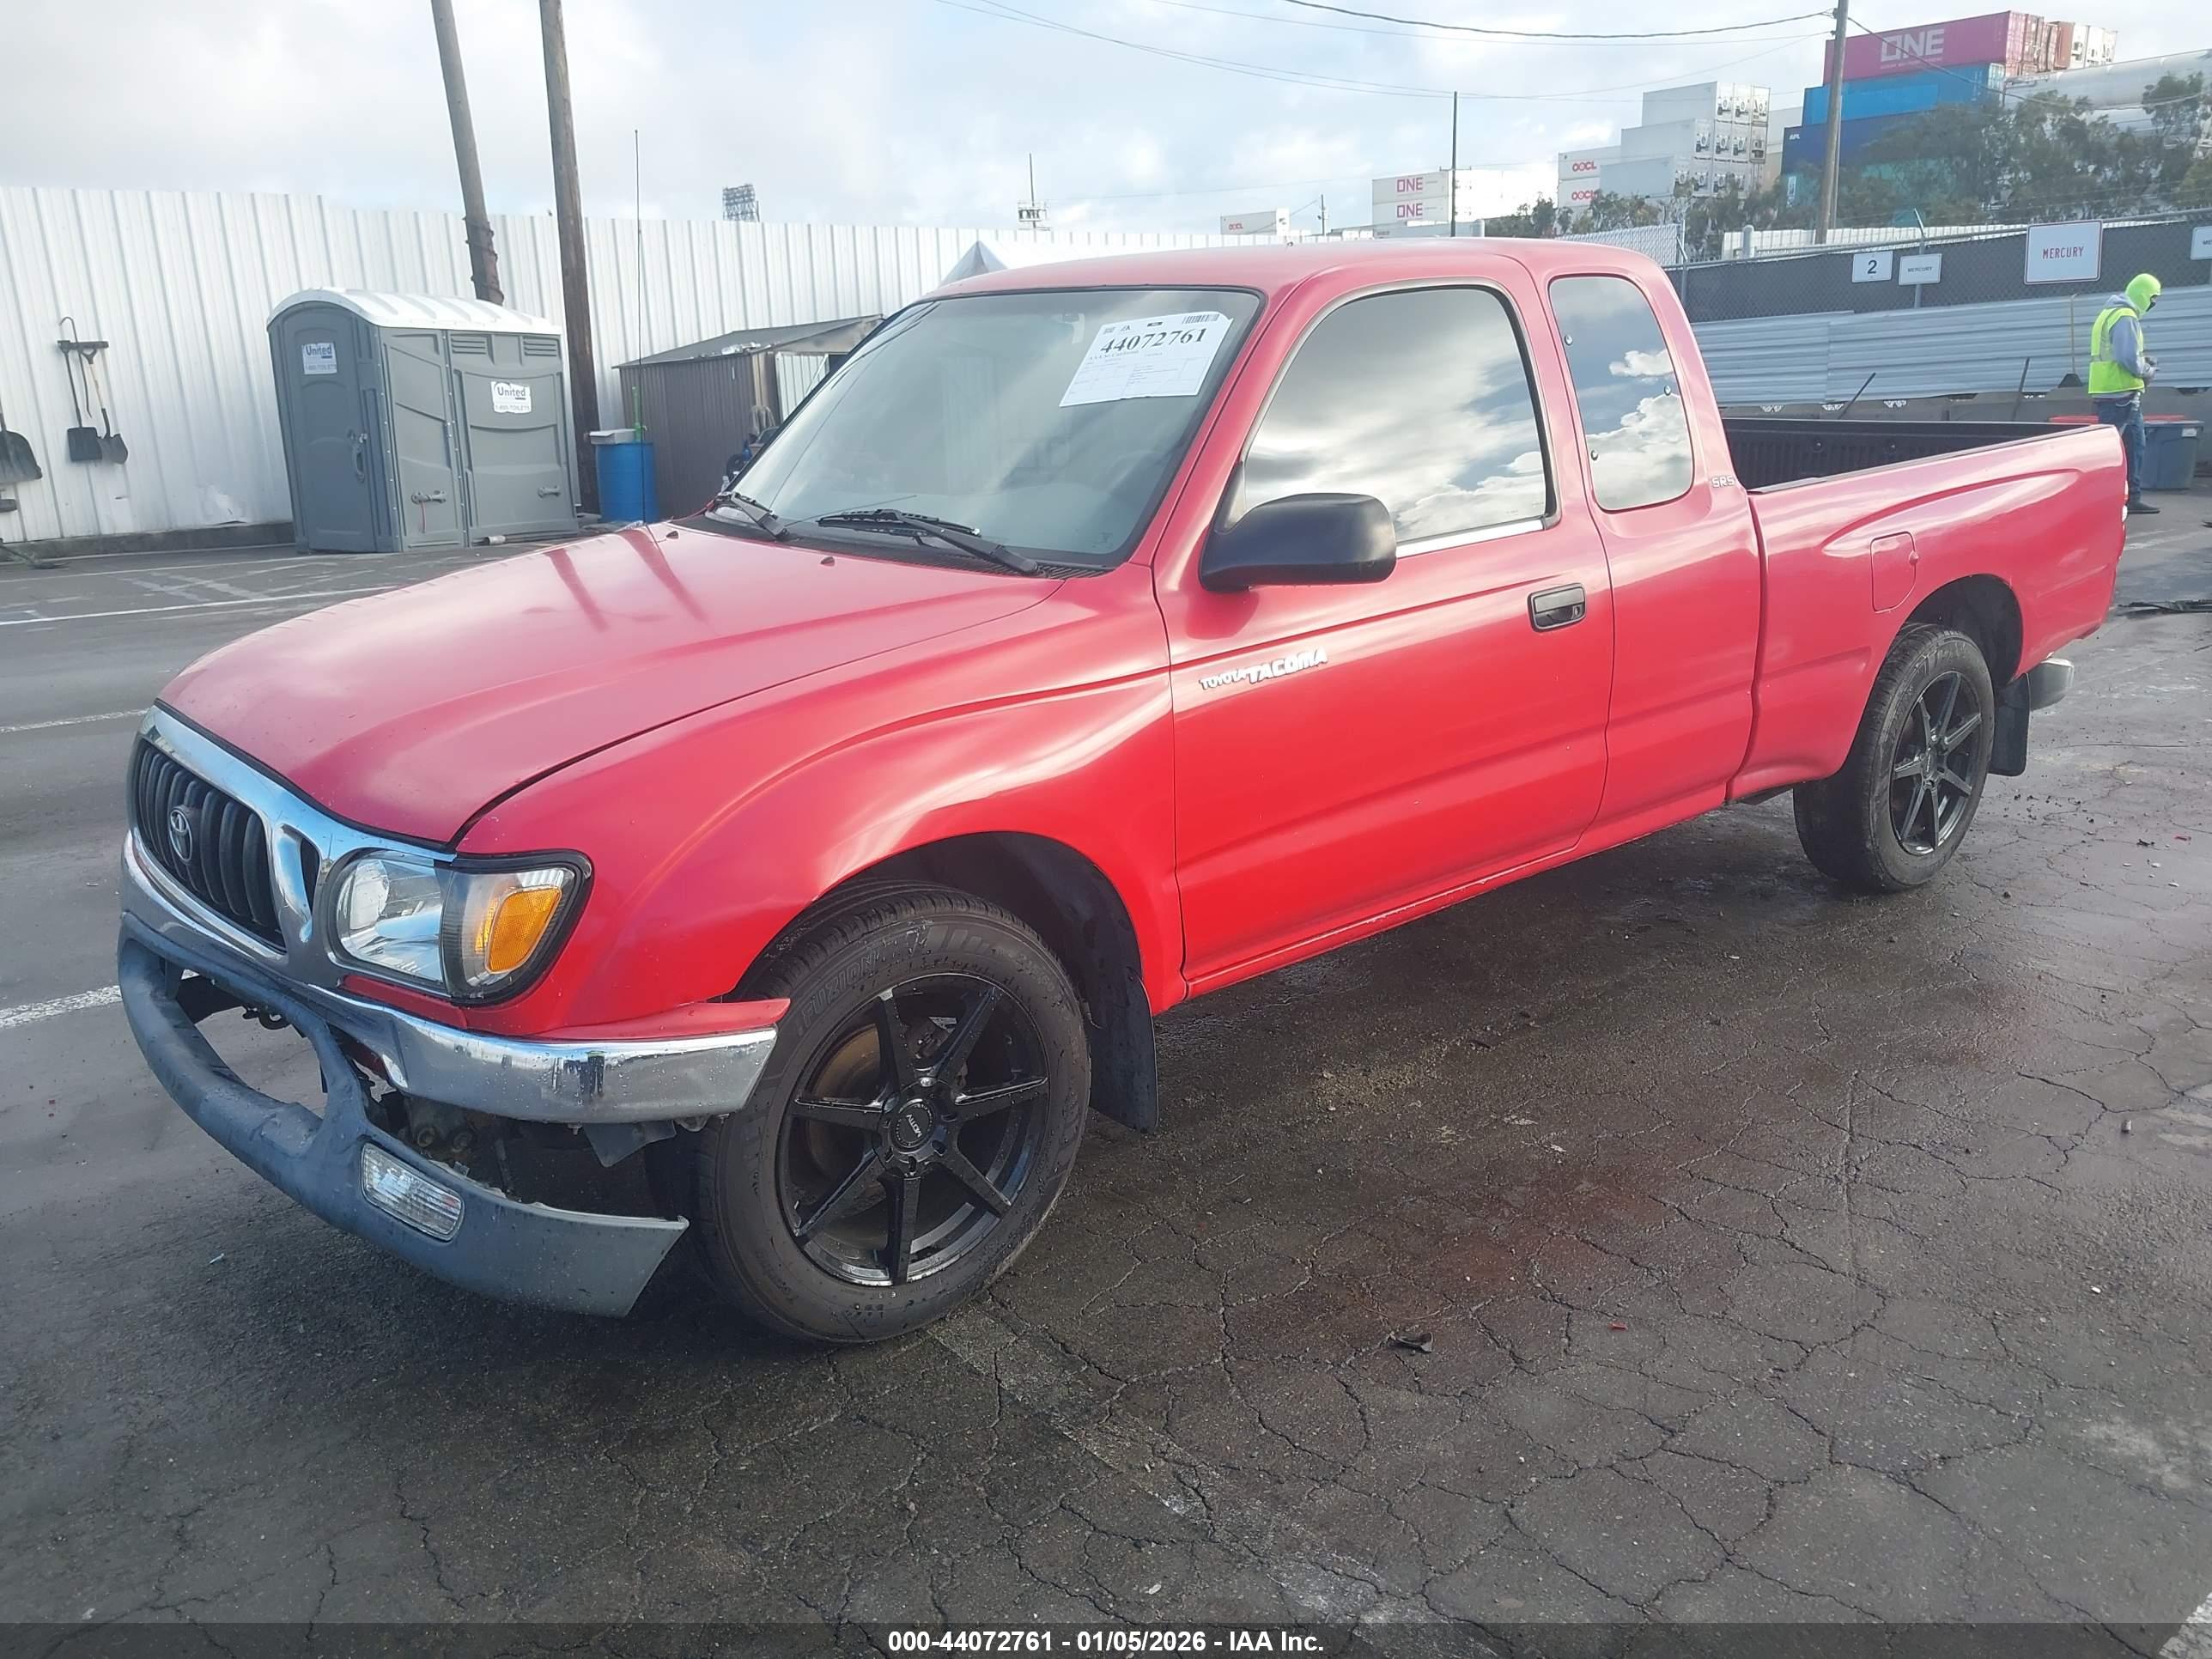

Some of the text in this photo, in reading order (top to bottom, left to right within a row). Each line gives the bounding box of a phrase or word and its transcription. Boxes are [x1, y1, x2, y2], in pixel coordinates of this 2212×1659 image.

[1881, 28, 1945, 62] ONE
[1572, 161, 1597, 173] OOCL
[1396, 177, 1424, 192] ONE
[1396, 203, 1423, 218] ONE
[2042, 246, 2085, 259] MERCURY
[1867, 259, 1877, 275] 2
[1101, 327, 1207, 353] 44072761
[306, 344, 333, 356] United
[497, 386, 526, 397] United
[1199, 647, 1328, 690] TOYOTA TACOMA
